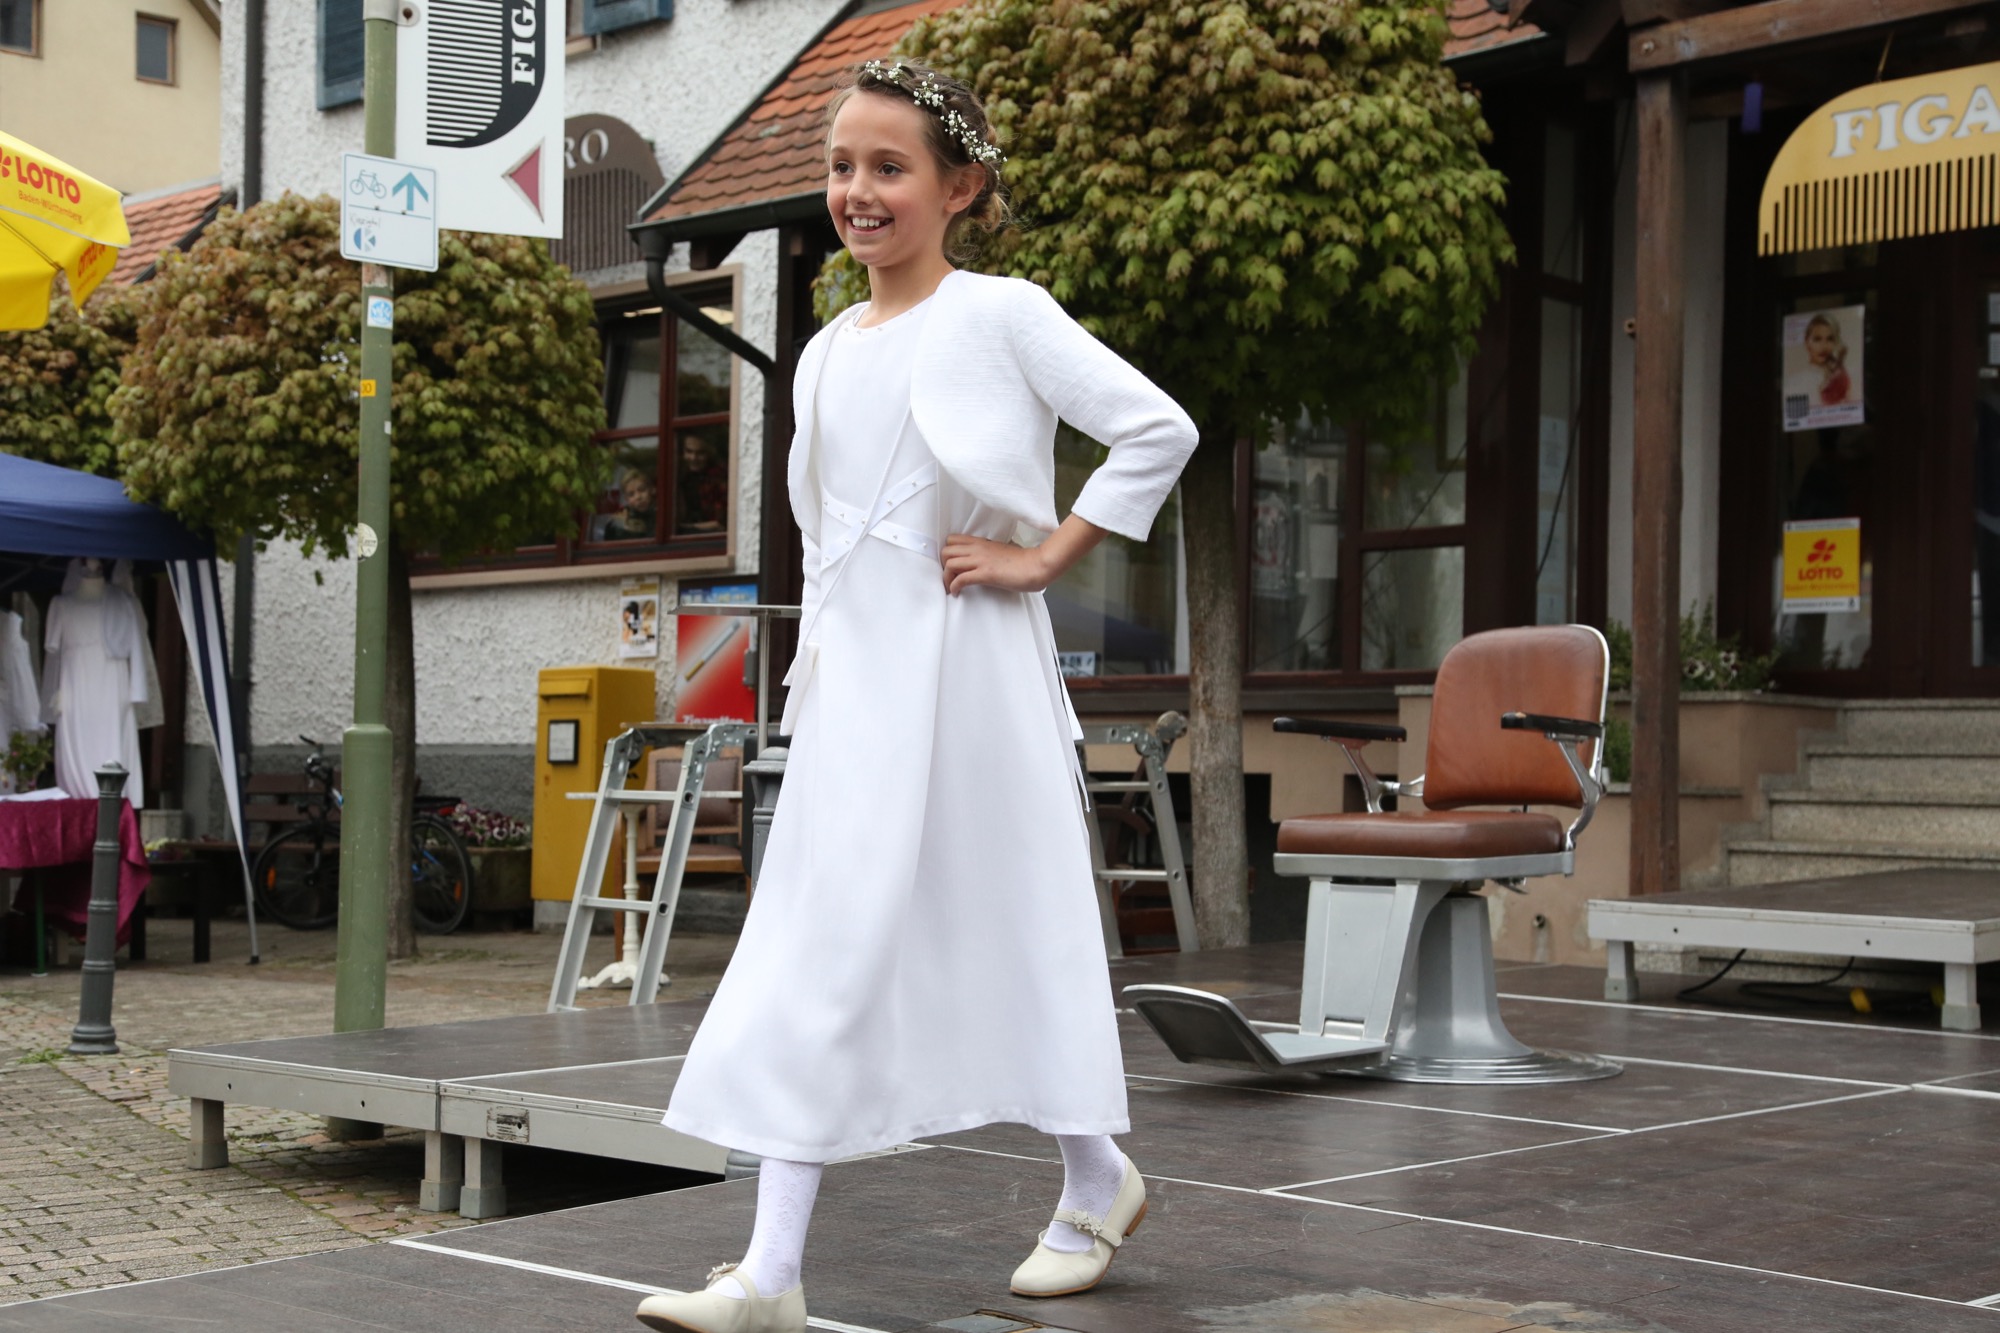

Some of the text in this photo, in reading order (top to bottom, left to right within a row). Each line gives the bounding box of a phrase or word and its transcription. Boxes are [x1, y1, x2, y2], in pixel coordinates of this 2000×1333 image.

[511, 0, 537, 86] FIG
[1829, 84, 2000, 158] FIGA
[15, 155, 81, 204] LOTTO
[1798, 567, 1843, 580] LOTTO
